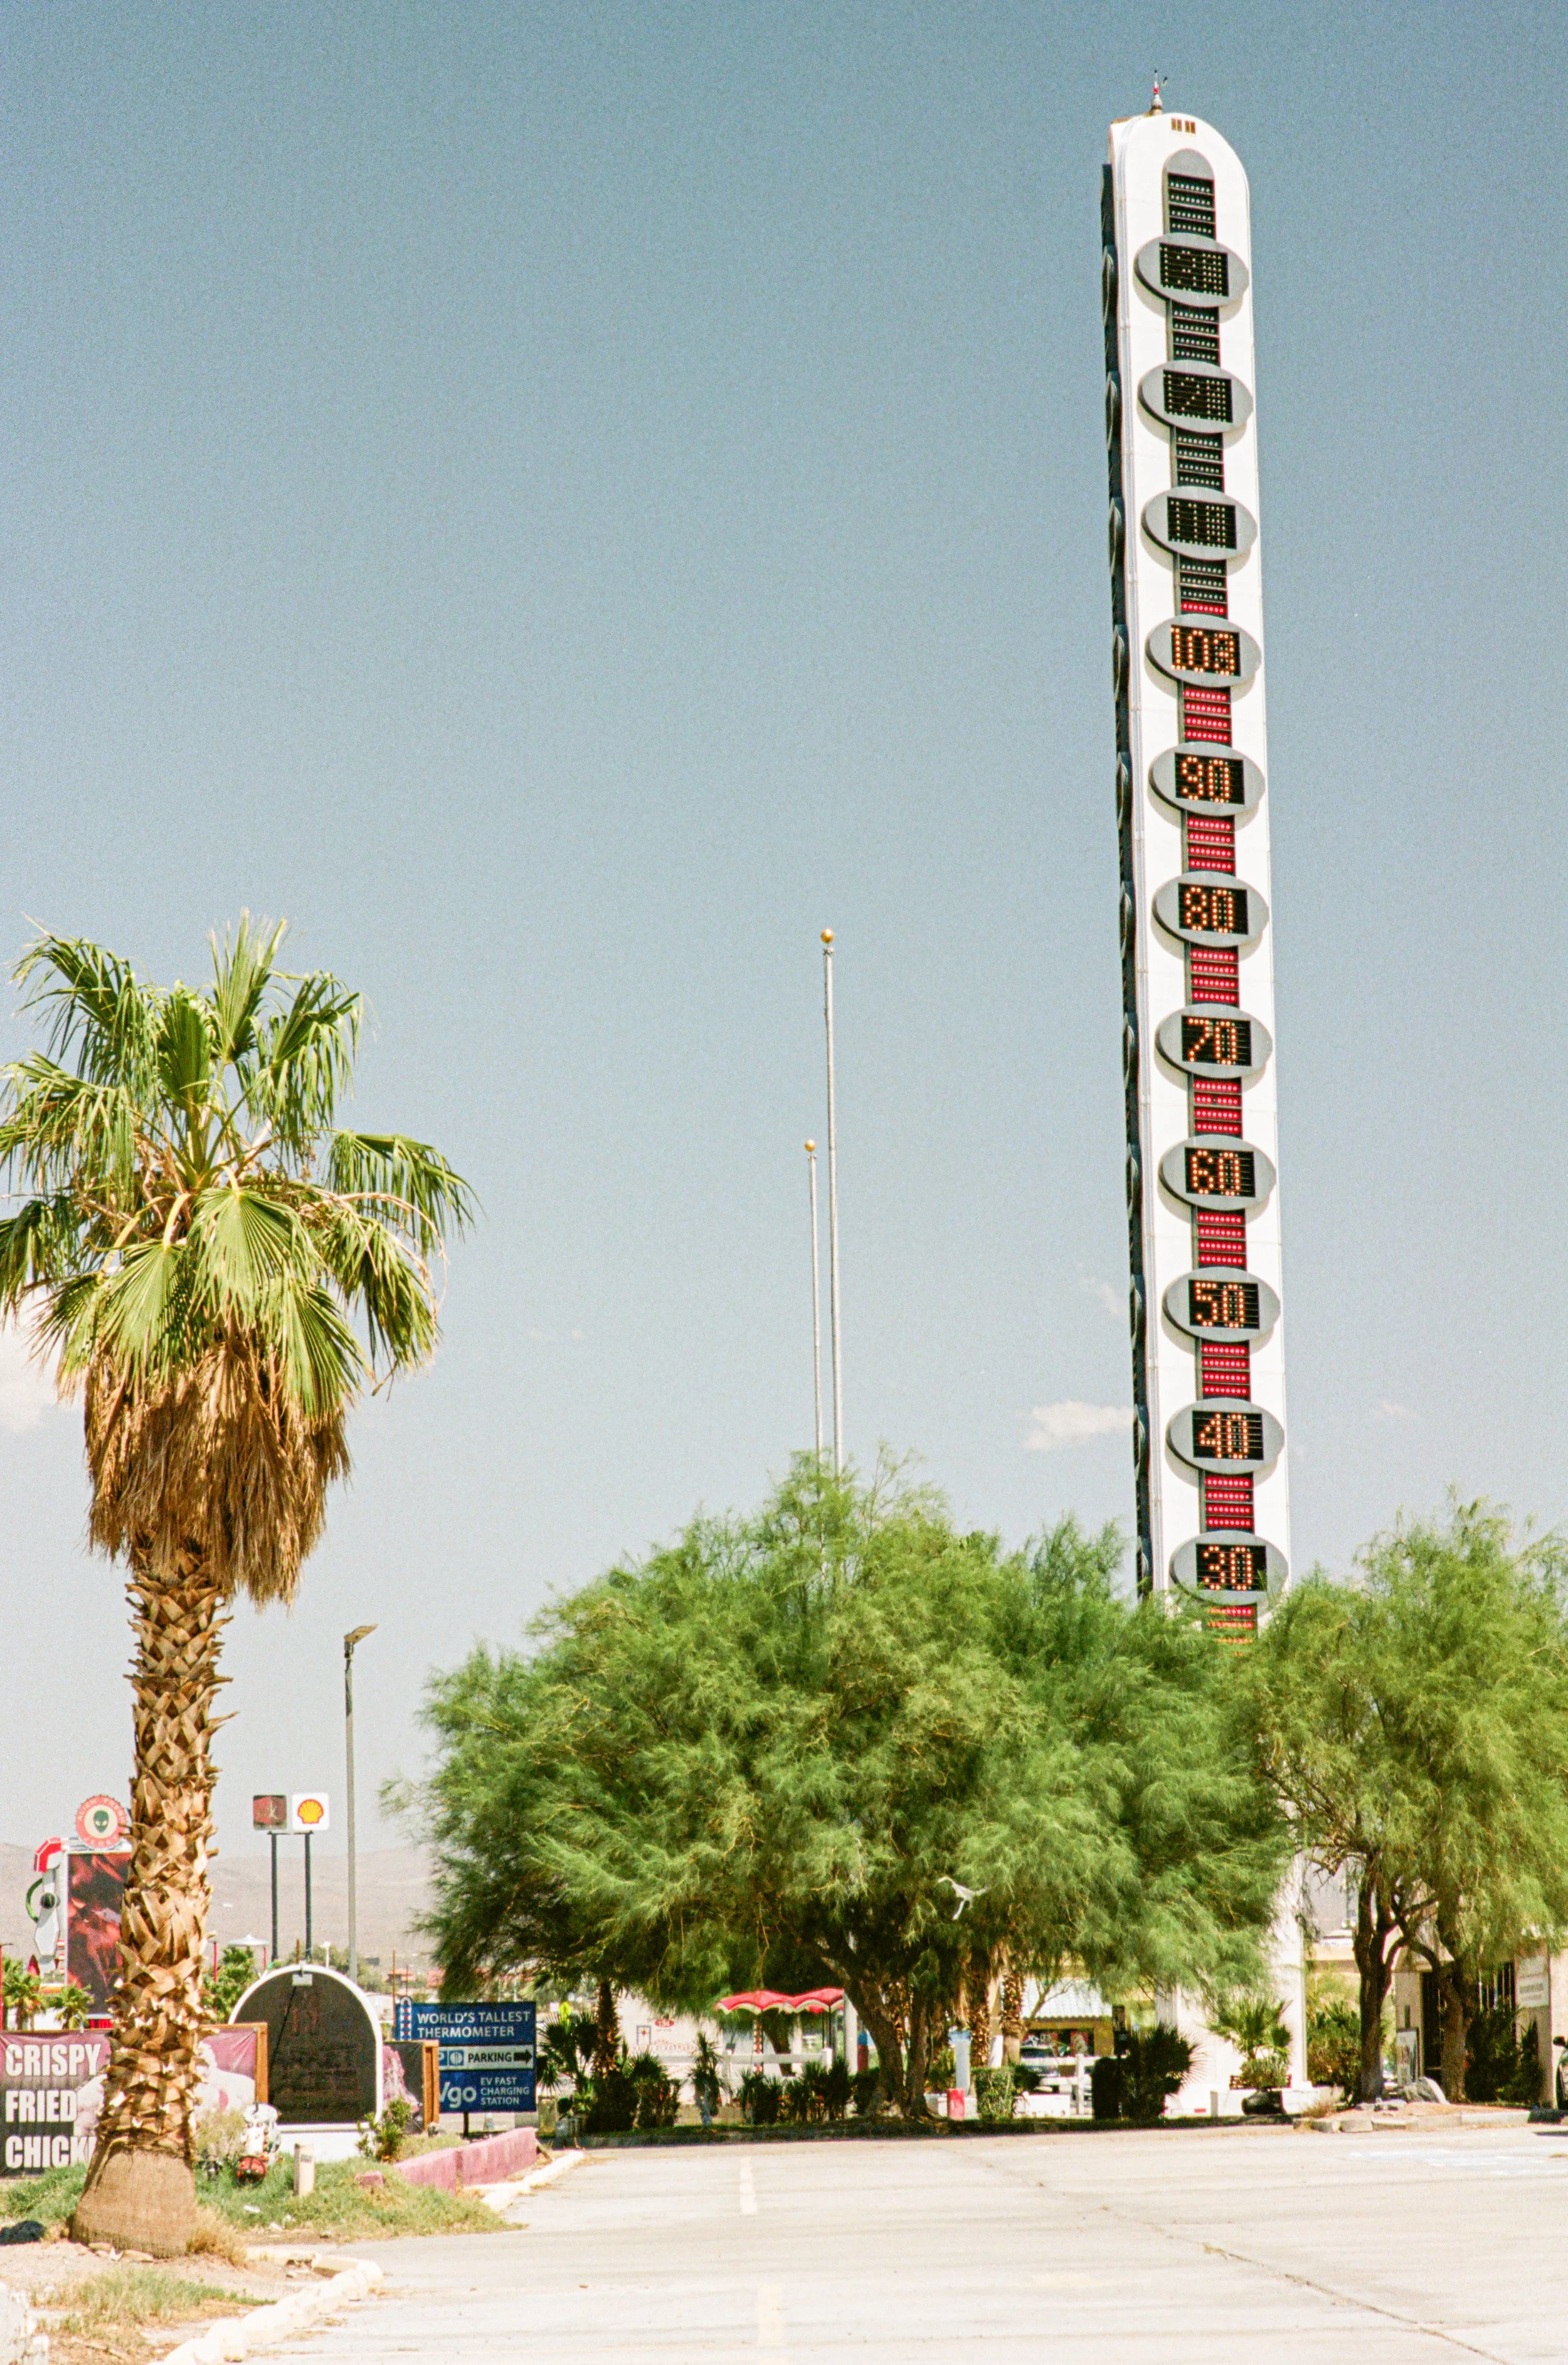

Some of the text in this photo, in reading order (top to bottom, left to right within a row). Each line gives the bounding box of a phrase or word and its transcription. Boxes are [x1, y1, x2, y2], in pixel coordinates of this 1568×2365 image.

[1181, 755, 1230, 804] 90
[1185, 886, 1234, 933] 80
[1187, 1018, 1237, 1065] 70
[1192, 1149, 1241, 1197] 60
[1194, 1281, 1246, 1329] 50
[1199, 1412, 1249, 1459] 40
[1203, 1545, 1253, 1591] 30
[417, 2011, 531, 2024] WORLD'S TALLEST
[417, 2026, 515, 2038] THERMOMETER
[6, 2044, 102, 2076] CRISPY
[468, 2051, 513, 2063] PARKING
[480, 2076, 517, 2085] EV FAST
[480, 2086, 530, 2096] CHARGING
[6, 2090, 77, 2122] FRIED
[480, 2097, 520, 2106] STATION
